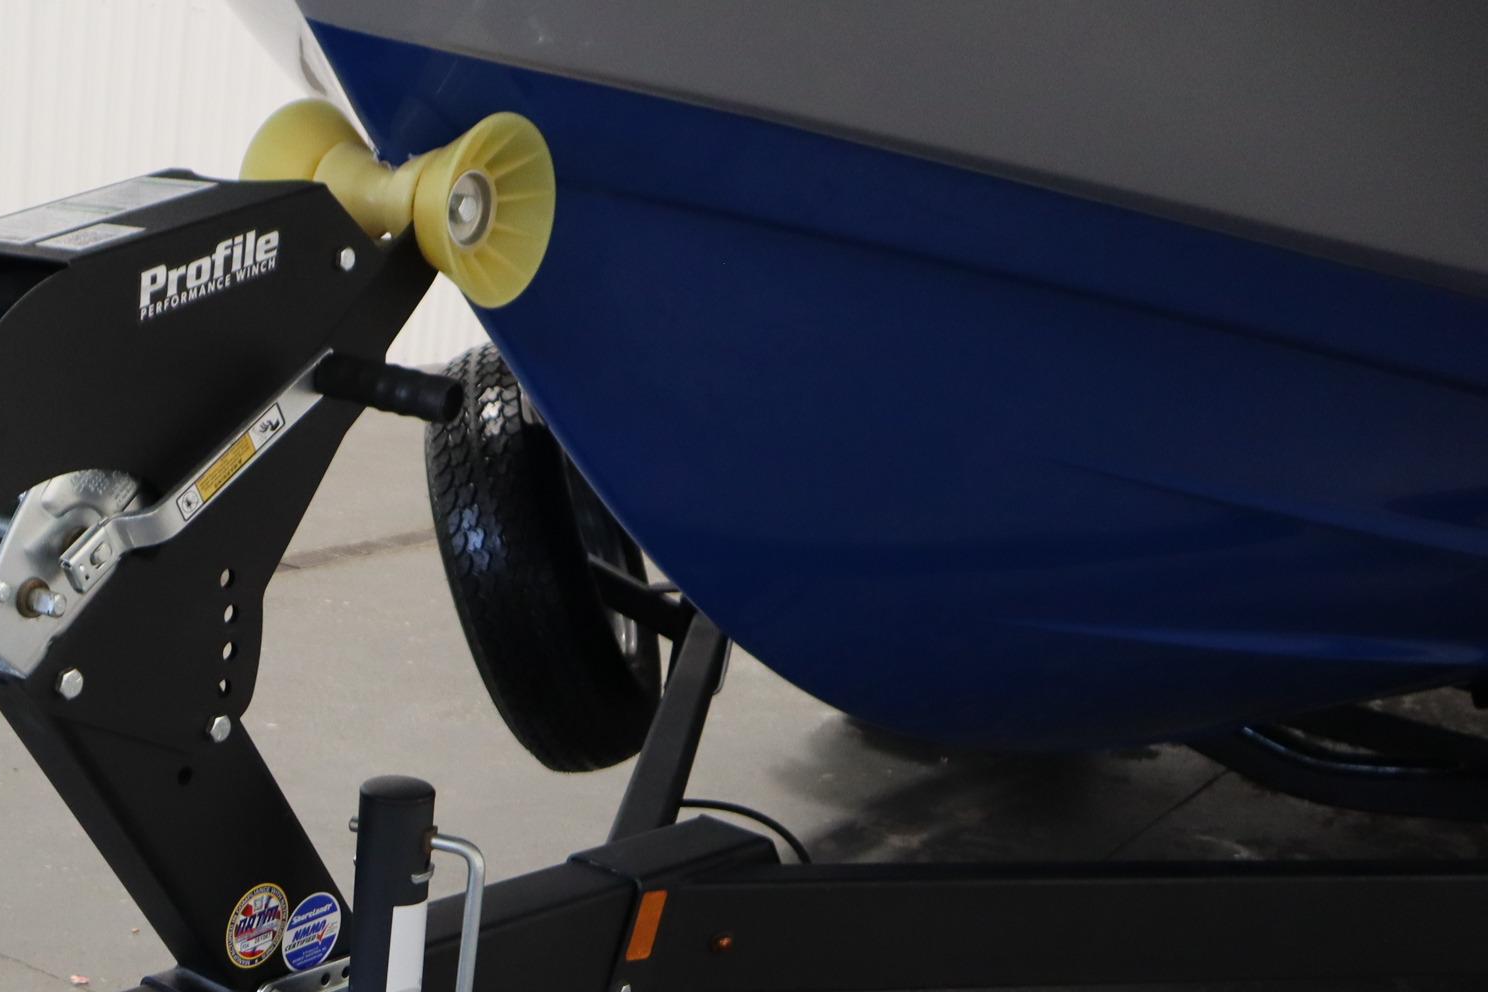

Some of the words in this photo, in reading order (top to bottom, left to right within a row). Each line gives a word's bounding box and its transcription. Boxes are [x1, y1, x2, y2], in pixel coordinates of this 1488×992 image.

[139, 229, 280, 309] Profile
[140, 272, 232, 321] PERFORMANCE
[235, 257, 277, 283] WINCH
